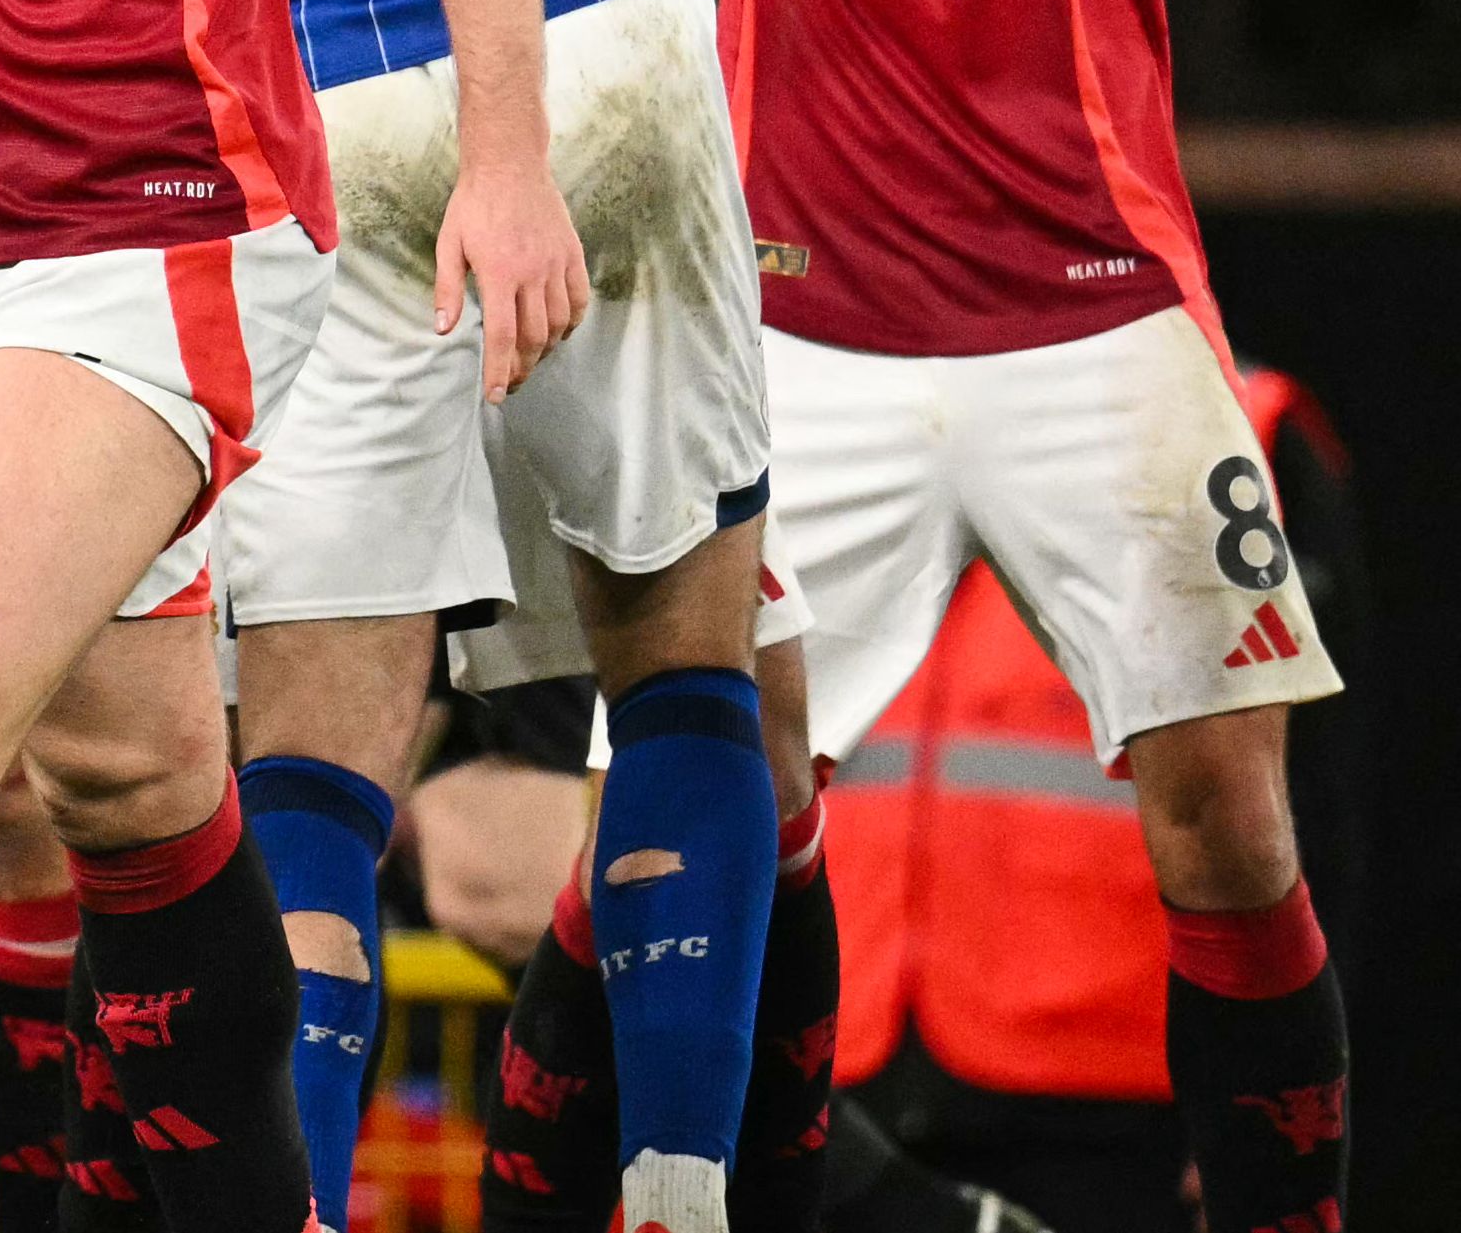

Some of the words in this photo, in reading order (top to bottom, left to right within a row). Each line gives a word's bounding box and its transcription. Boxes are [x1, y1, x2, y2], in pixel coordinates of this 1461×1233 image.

[143, 181, 216, 199] HEAT.RDY
[1207, 455, 1289, 592] 8
[302, 1023, 365, 1056] FC
